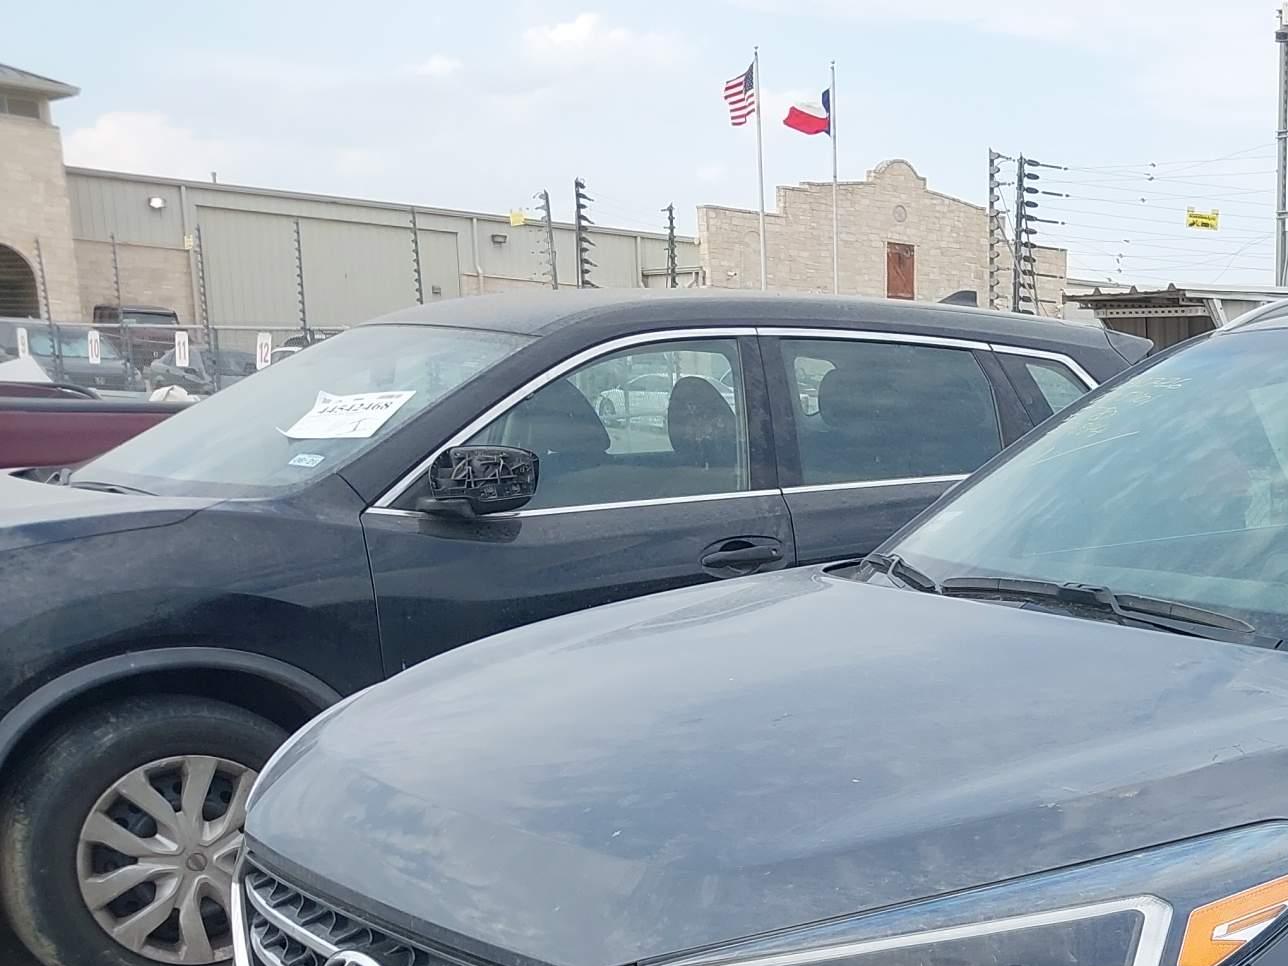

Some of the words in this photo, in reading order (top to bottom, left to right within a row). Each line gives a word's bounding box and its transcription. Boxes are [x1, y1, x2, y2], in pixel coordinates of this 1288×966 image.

[90, 337, 100, 358] 10
[177, 340, 188, 361] 11
[259, 342, 270, 364] 12
